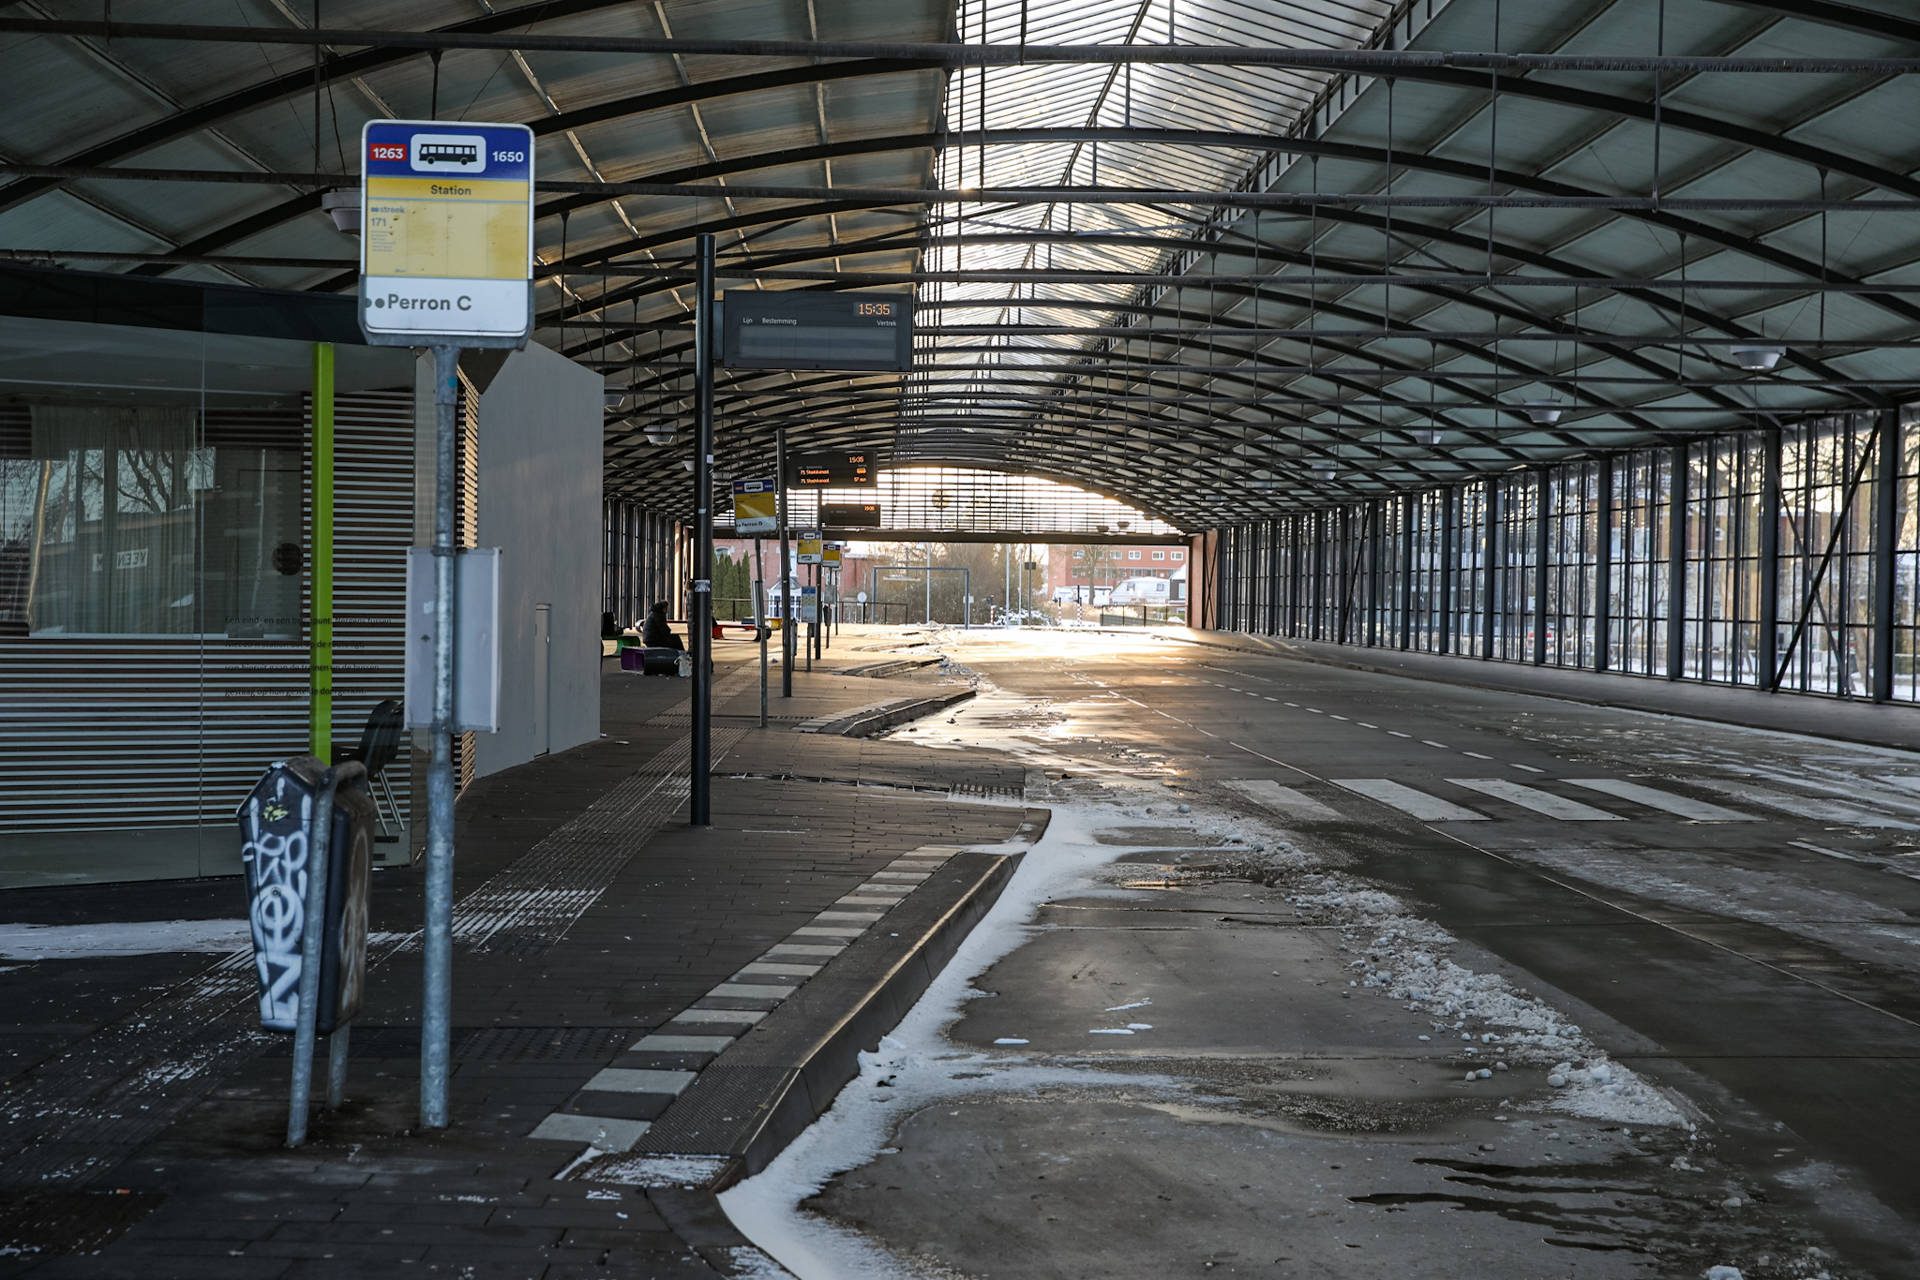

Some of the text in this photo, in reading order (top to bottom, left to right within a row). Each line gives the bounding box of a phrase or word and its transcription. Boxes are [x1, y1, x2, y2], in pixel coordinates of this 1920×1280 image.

[372, 147, 404, 160] 1263
[492, 151, 524, 162] 1650
[430, 184, 472, 196] Station
[371, 217, 386, 226] 171
[388, 294, 472, 310] Perron C
[858, 303, 890, 316] 15:35
[762, 317, 797, 326] Bestemming
